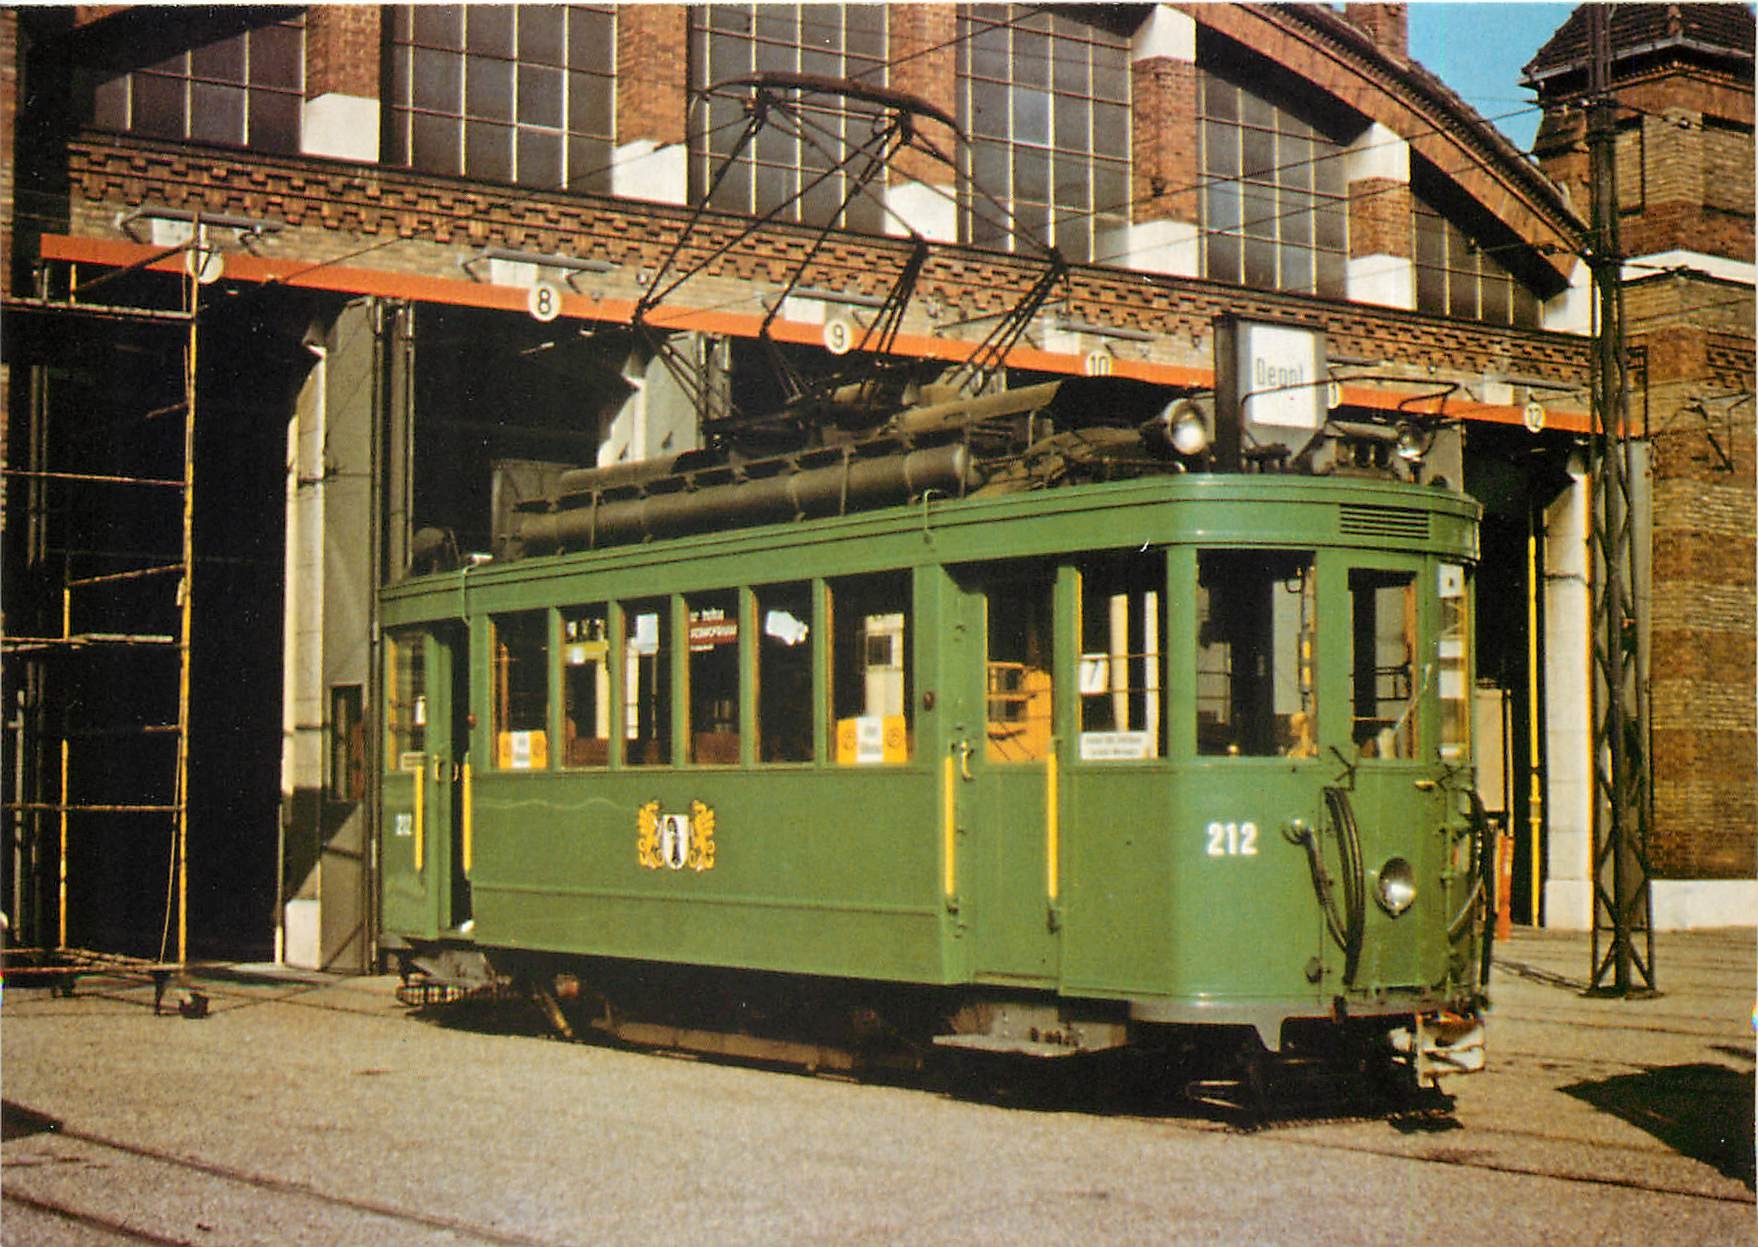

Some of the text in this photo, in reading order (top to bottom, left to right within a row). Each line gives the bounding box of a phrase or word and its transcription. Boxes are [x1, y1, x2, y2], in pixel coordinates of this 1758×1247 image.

[538, 288, 552, 315] 8
[832, 323, 845, 349] 9
[1091, 355, 1110, 376] 10
[1528, 407, 1543, 428] 12
[1207, 821, 1258, 856] 212
